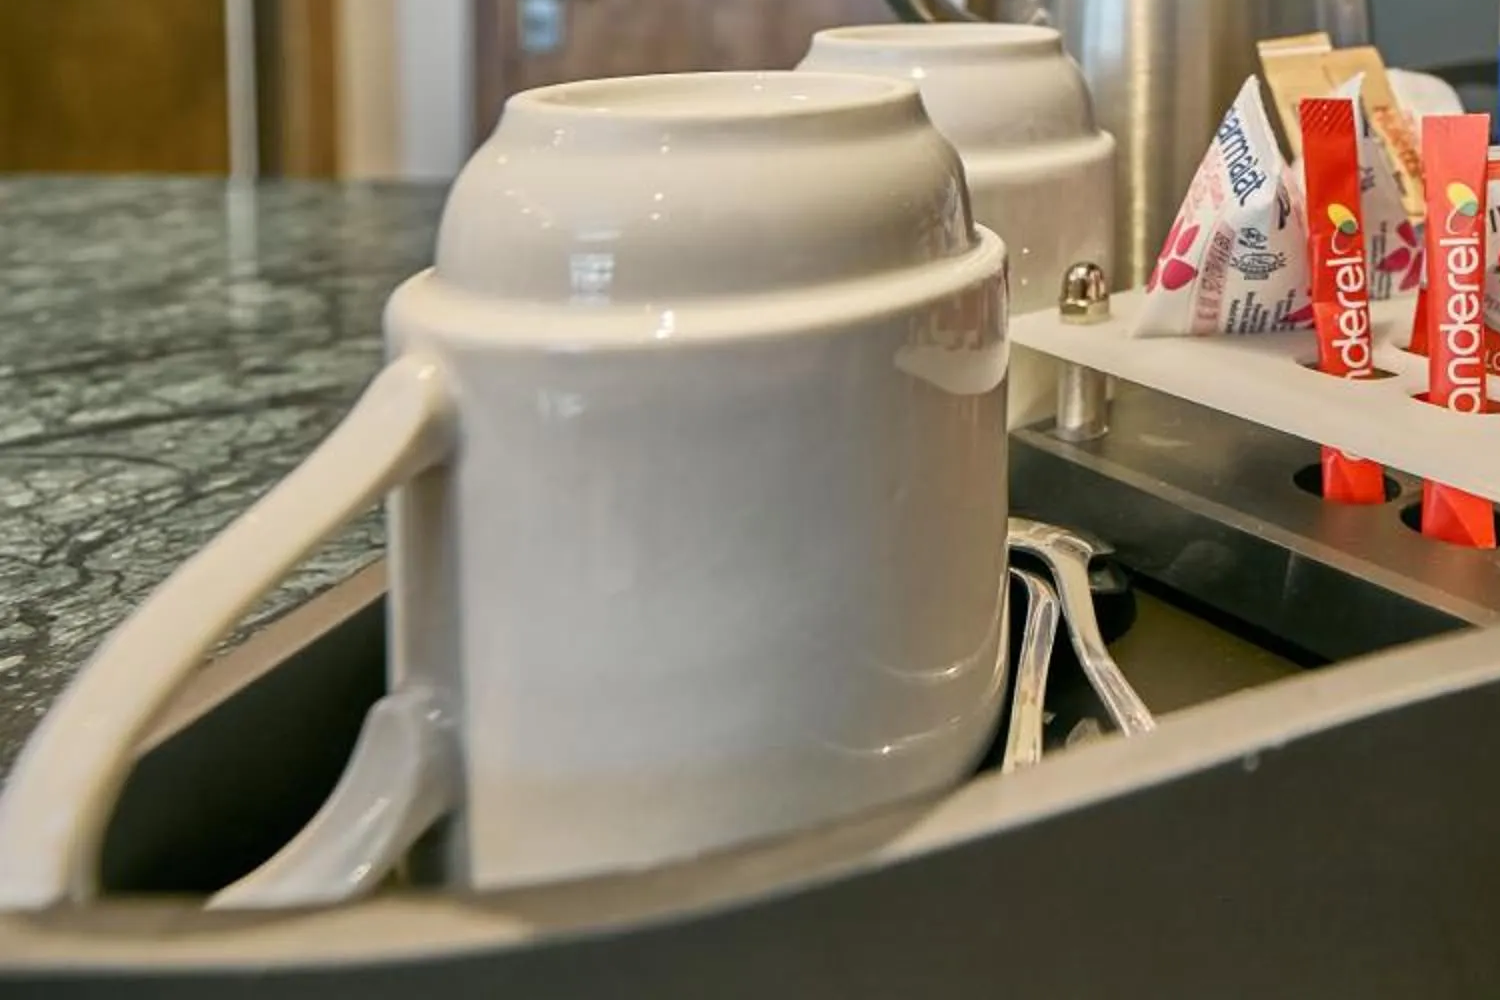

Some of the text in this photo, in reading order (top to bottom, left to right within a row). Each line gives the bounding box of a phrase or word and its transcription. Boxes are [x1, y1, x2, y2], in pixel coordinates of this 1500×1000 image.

[1216, 108, 1267, 207] armalat
[1327, 252, 1371, 379] nderel
[1439, 233, 1481, 414] anderel
